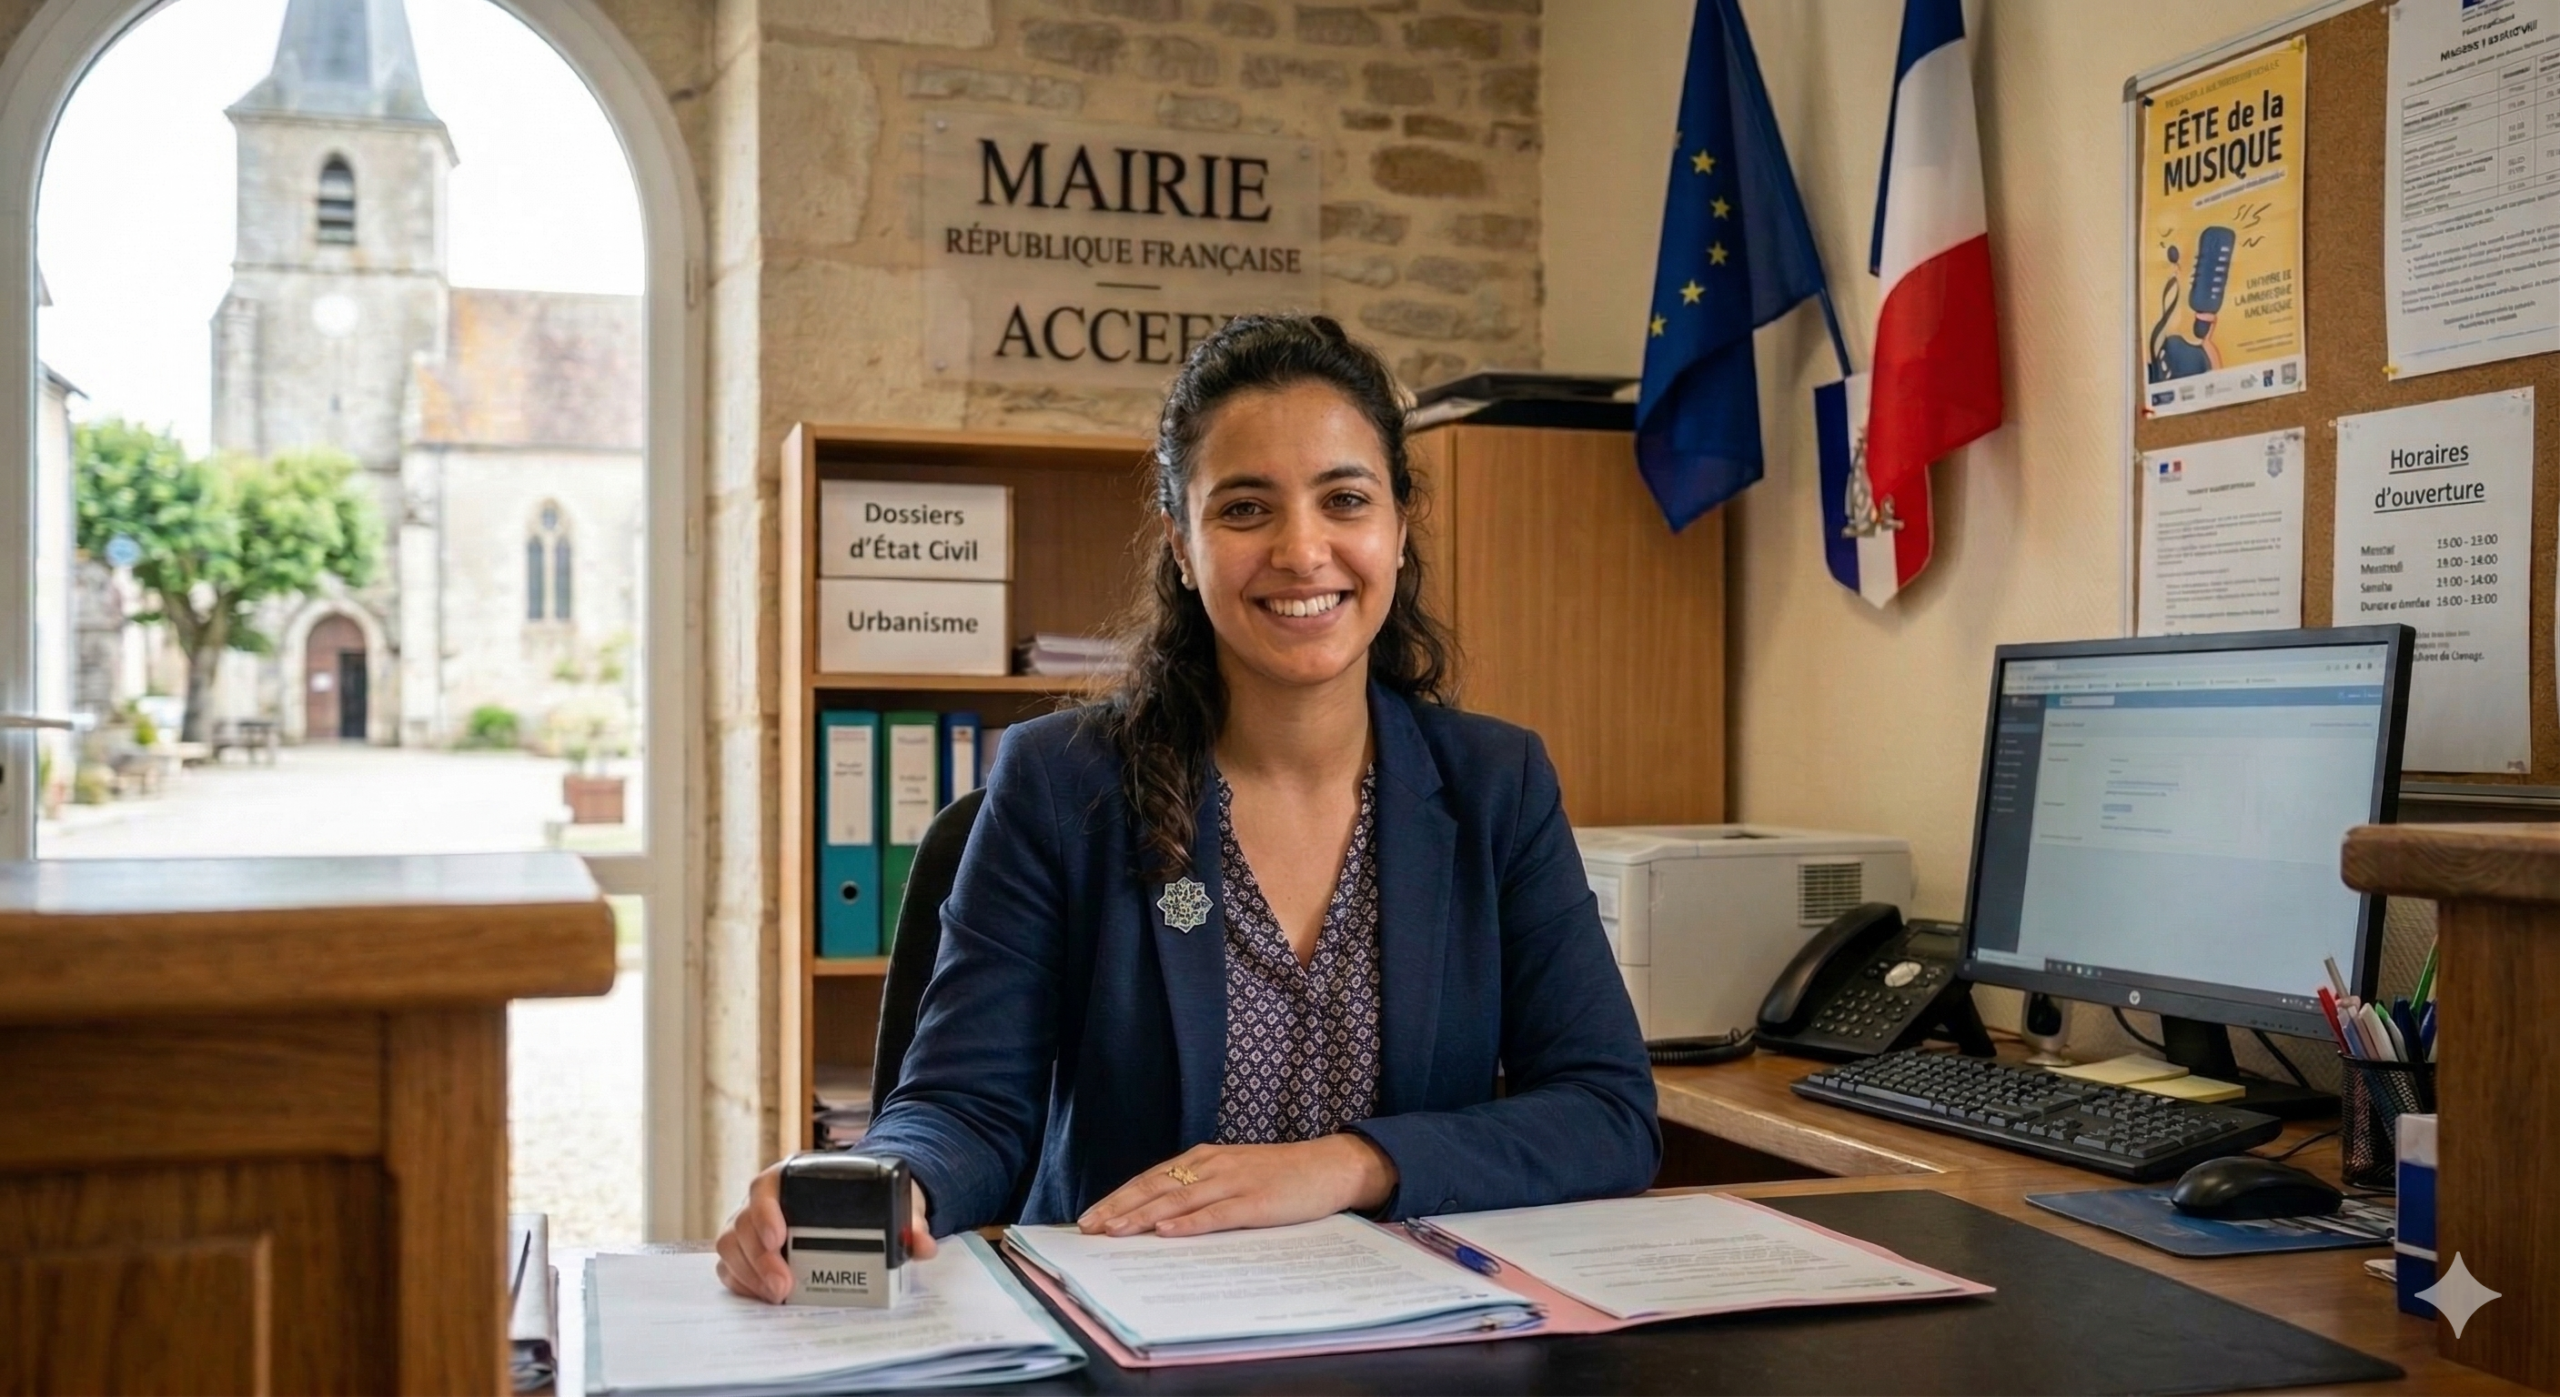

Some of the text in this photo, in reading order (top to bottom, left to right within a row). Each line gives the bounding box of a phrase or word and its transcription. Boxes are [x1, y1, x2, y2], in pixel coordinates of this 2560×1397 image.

[2164, 90, 2284, 154] FÊTE de la
[2164, 124, 2283, 196] MUSIQUE
[976, 138, 1272, 223] MAIRIE
[946, 223, 1302, 276] RÉPUBLIQUE FRANÇAISE
[2390, 443, 2470, 469] Horaires
[2374, 480, 2486, 508] d'ouverture
[865, 502, 965, 526] Dossiers
[850, 535, 979, 561] d'État Civil
[848, 610, 979, 634] Urbanisme
[811, 1269, 867, 1286] MAIRIE
